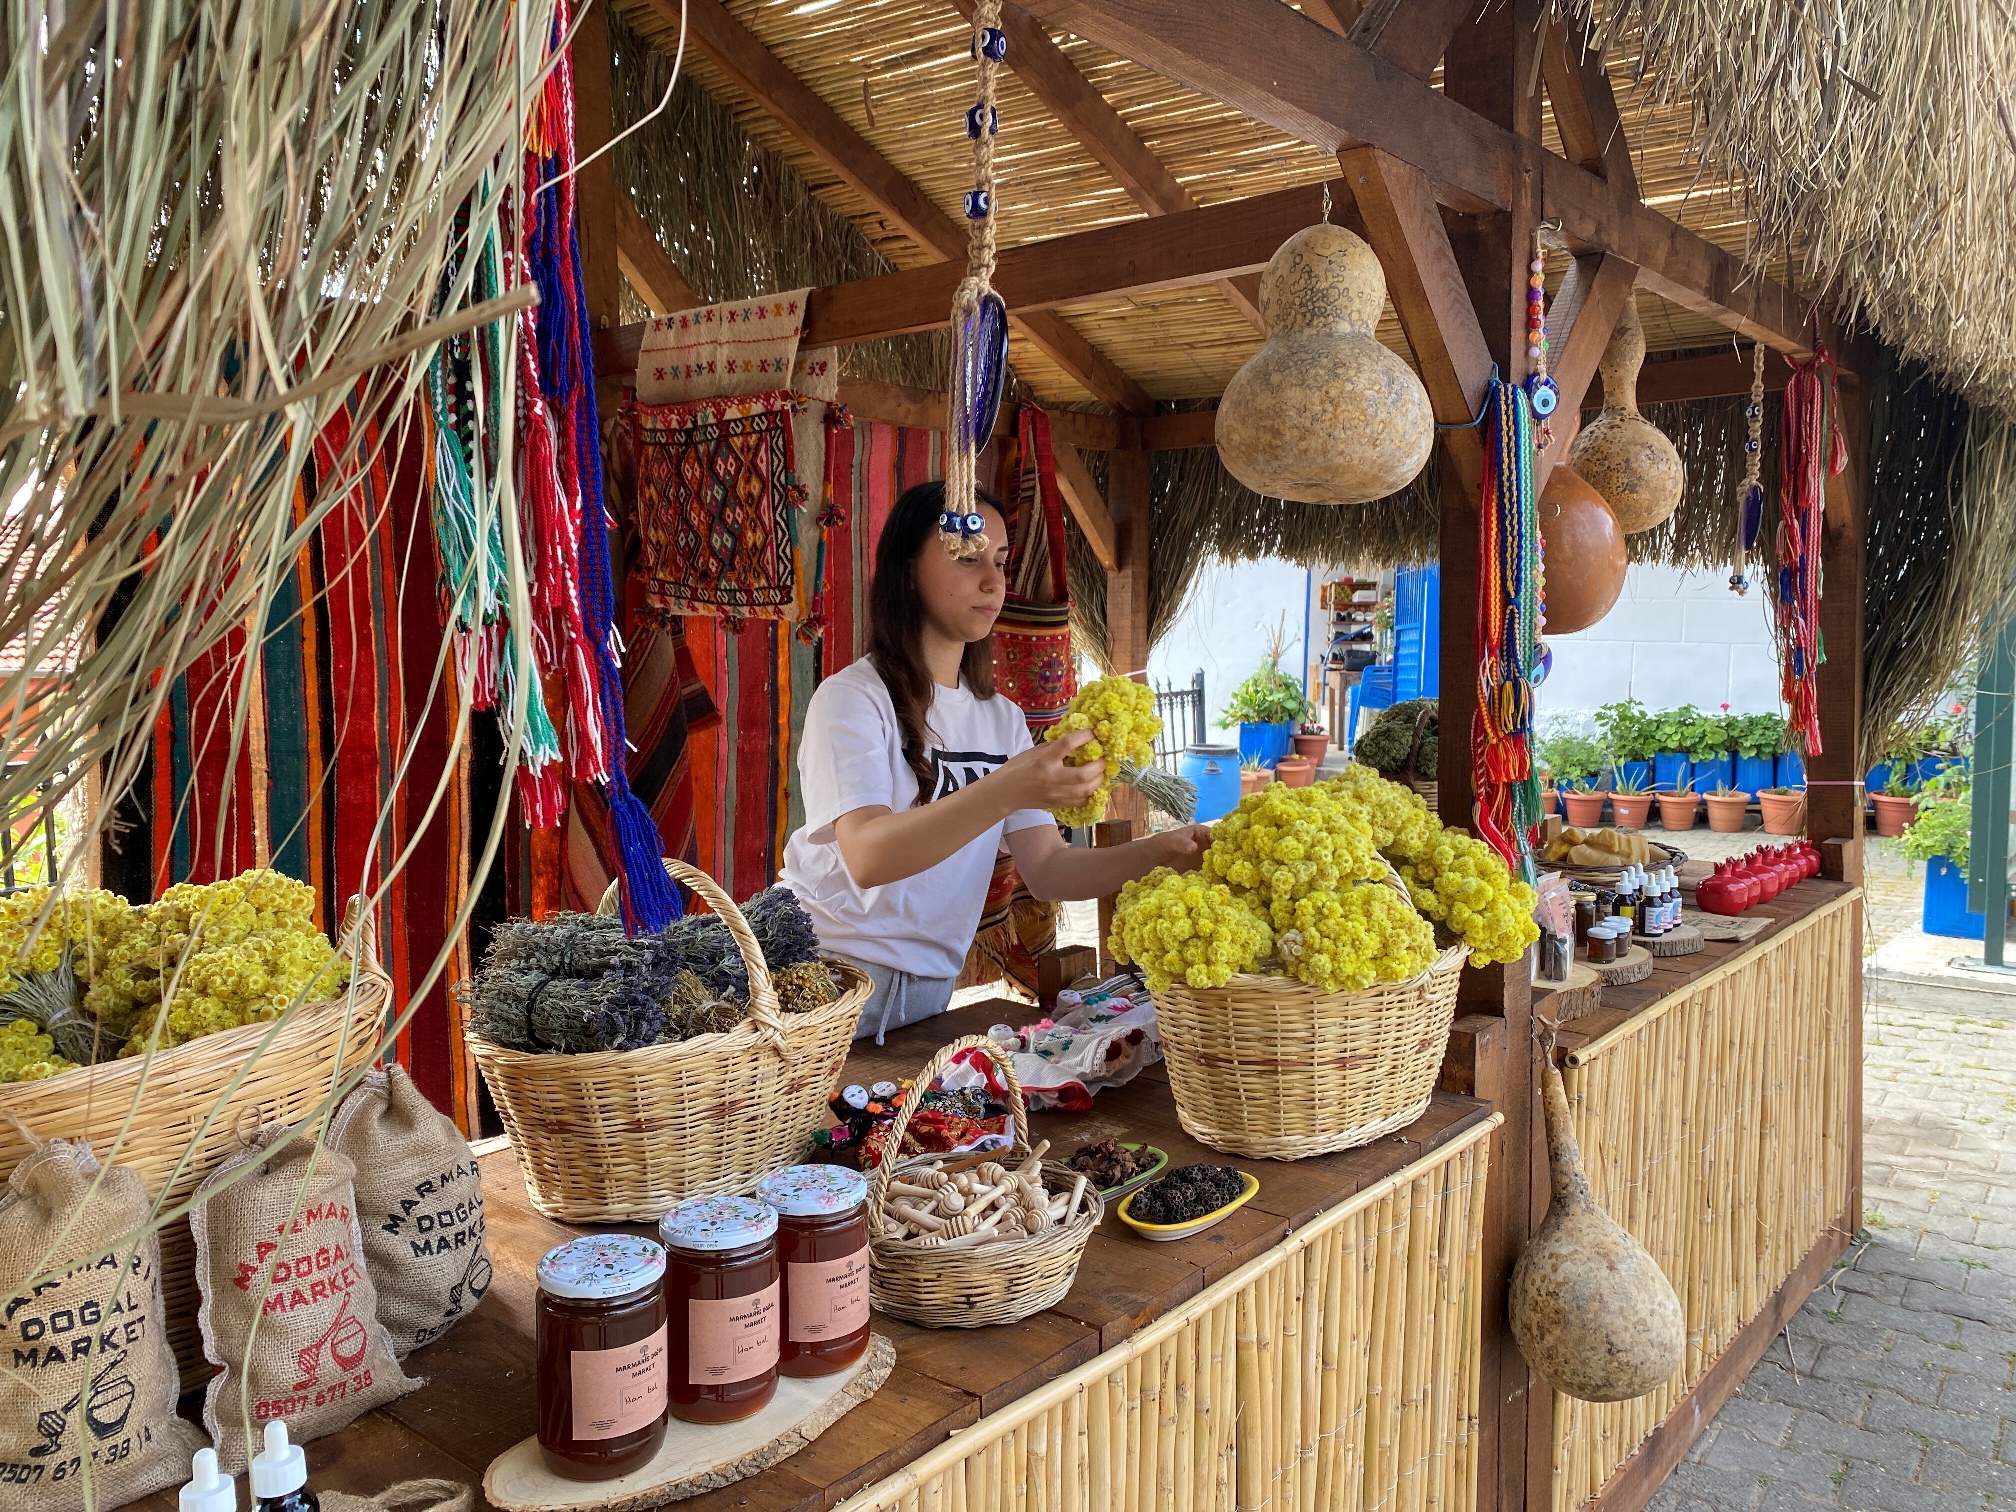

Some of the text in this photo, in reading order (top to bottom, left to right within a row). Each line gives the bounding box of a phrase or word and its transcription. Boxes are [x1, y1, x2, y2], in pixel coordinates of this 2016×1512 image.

[262, 1262, 361, 1316] MARKET
[12, 1314, 146, 1369] MARKET
[255, 1369, 373, 1420] 0507 677 38
